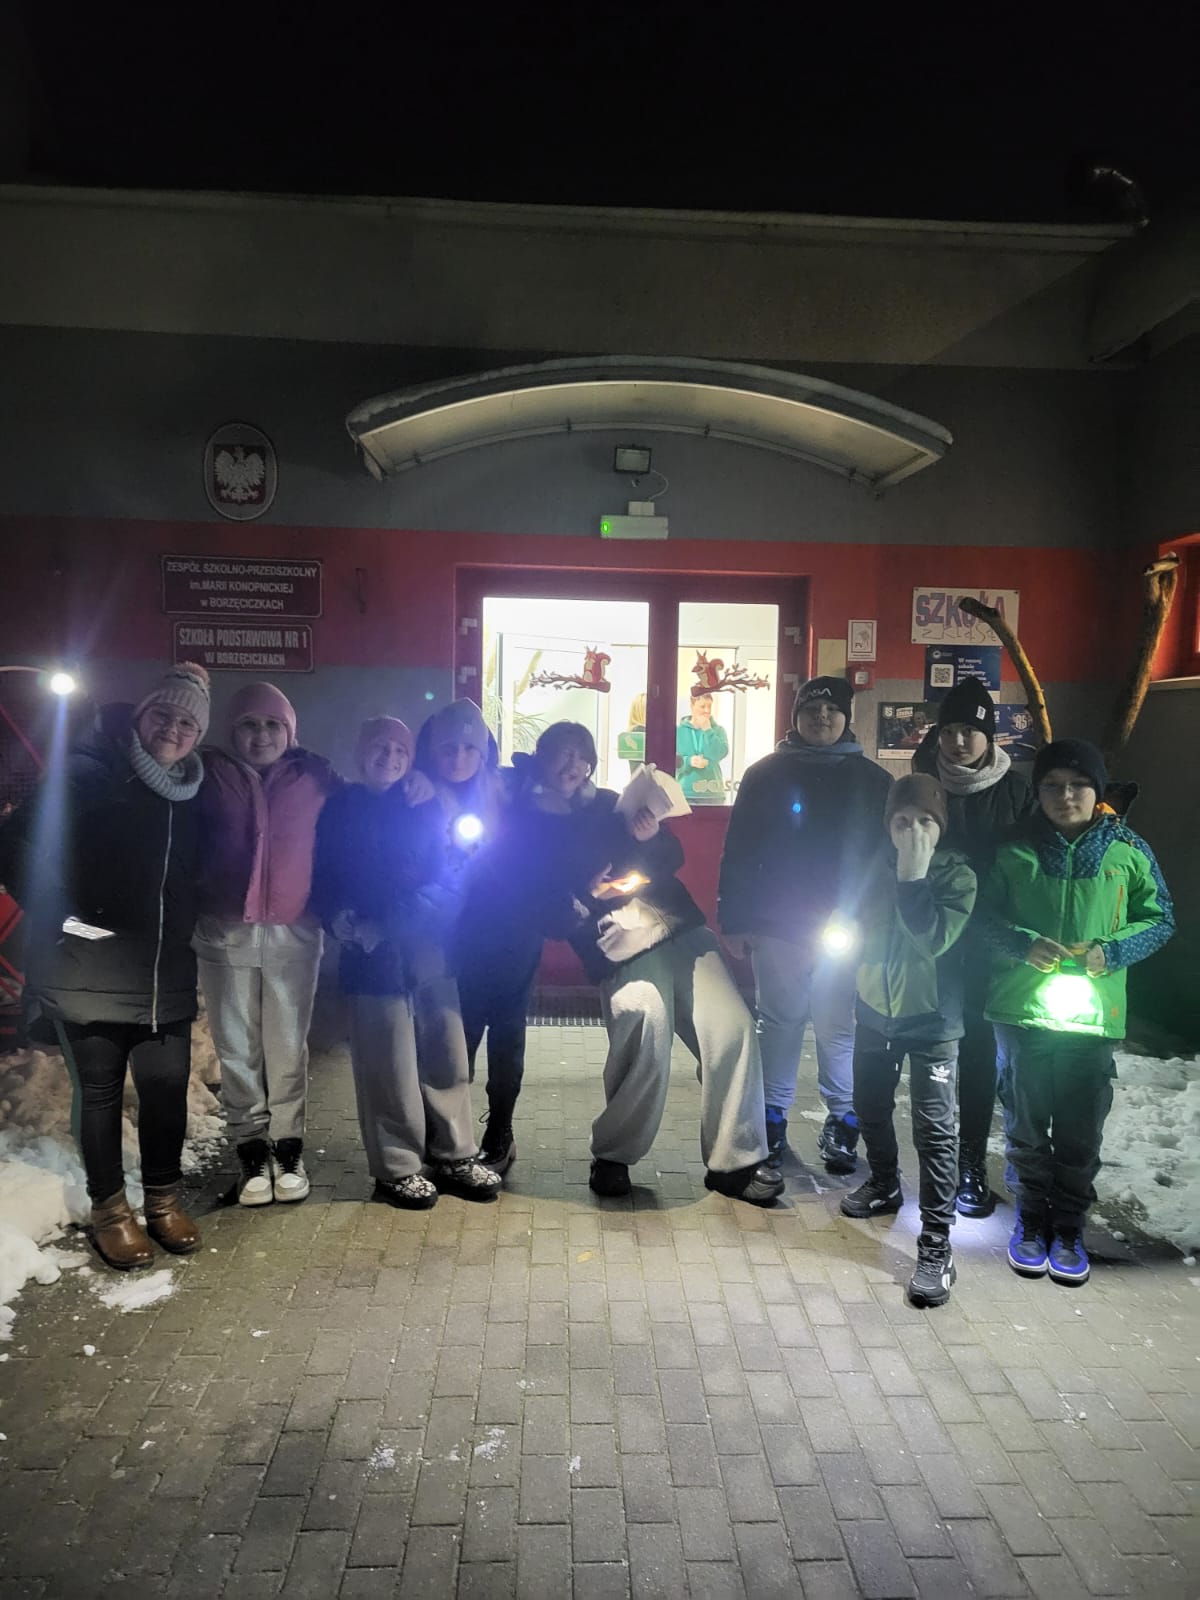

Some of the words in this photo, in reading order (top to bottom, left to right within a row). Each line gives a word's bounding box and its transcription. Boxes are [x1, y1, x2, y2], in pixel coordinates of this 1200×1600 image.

[167, 561, 202, 573] ZESPÓŁ
[229, 582, 294, 594] KONOPNICKIEJ
[179, 628, 215, 646] SZKOŁA
[217, 629, 283, 648] PODSTAWOWA
[285, 631, 299, 648] NR
[302, 631, 308, 648] 1
